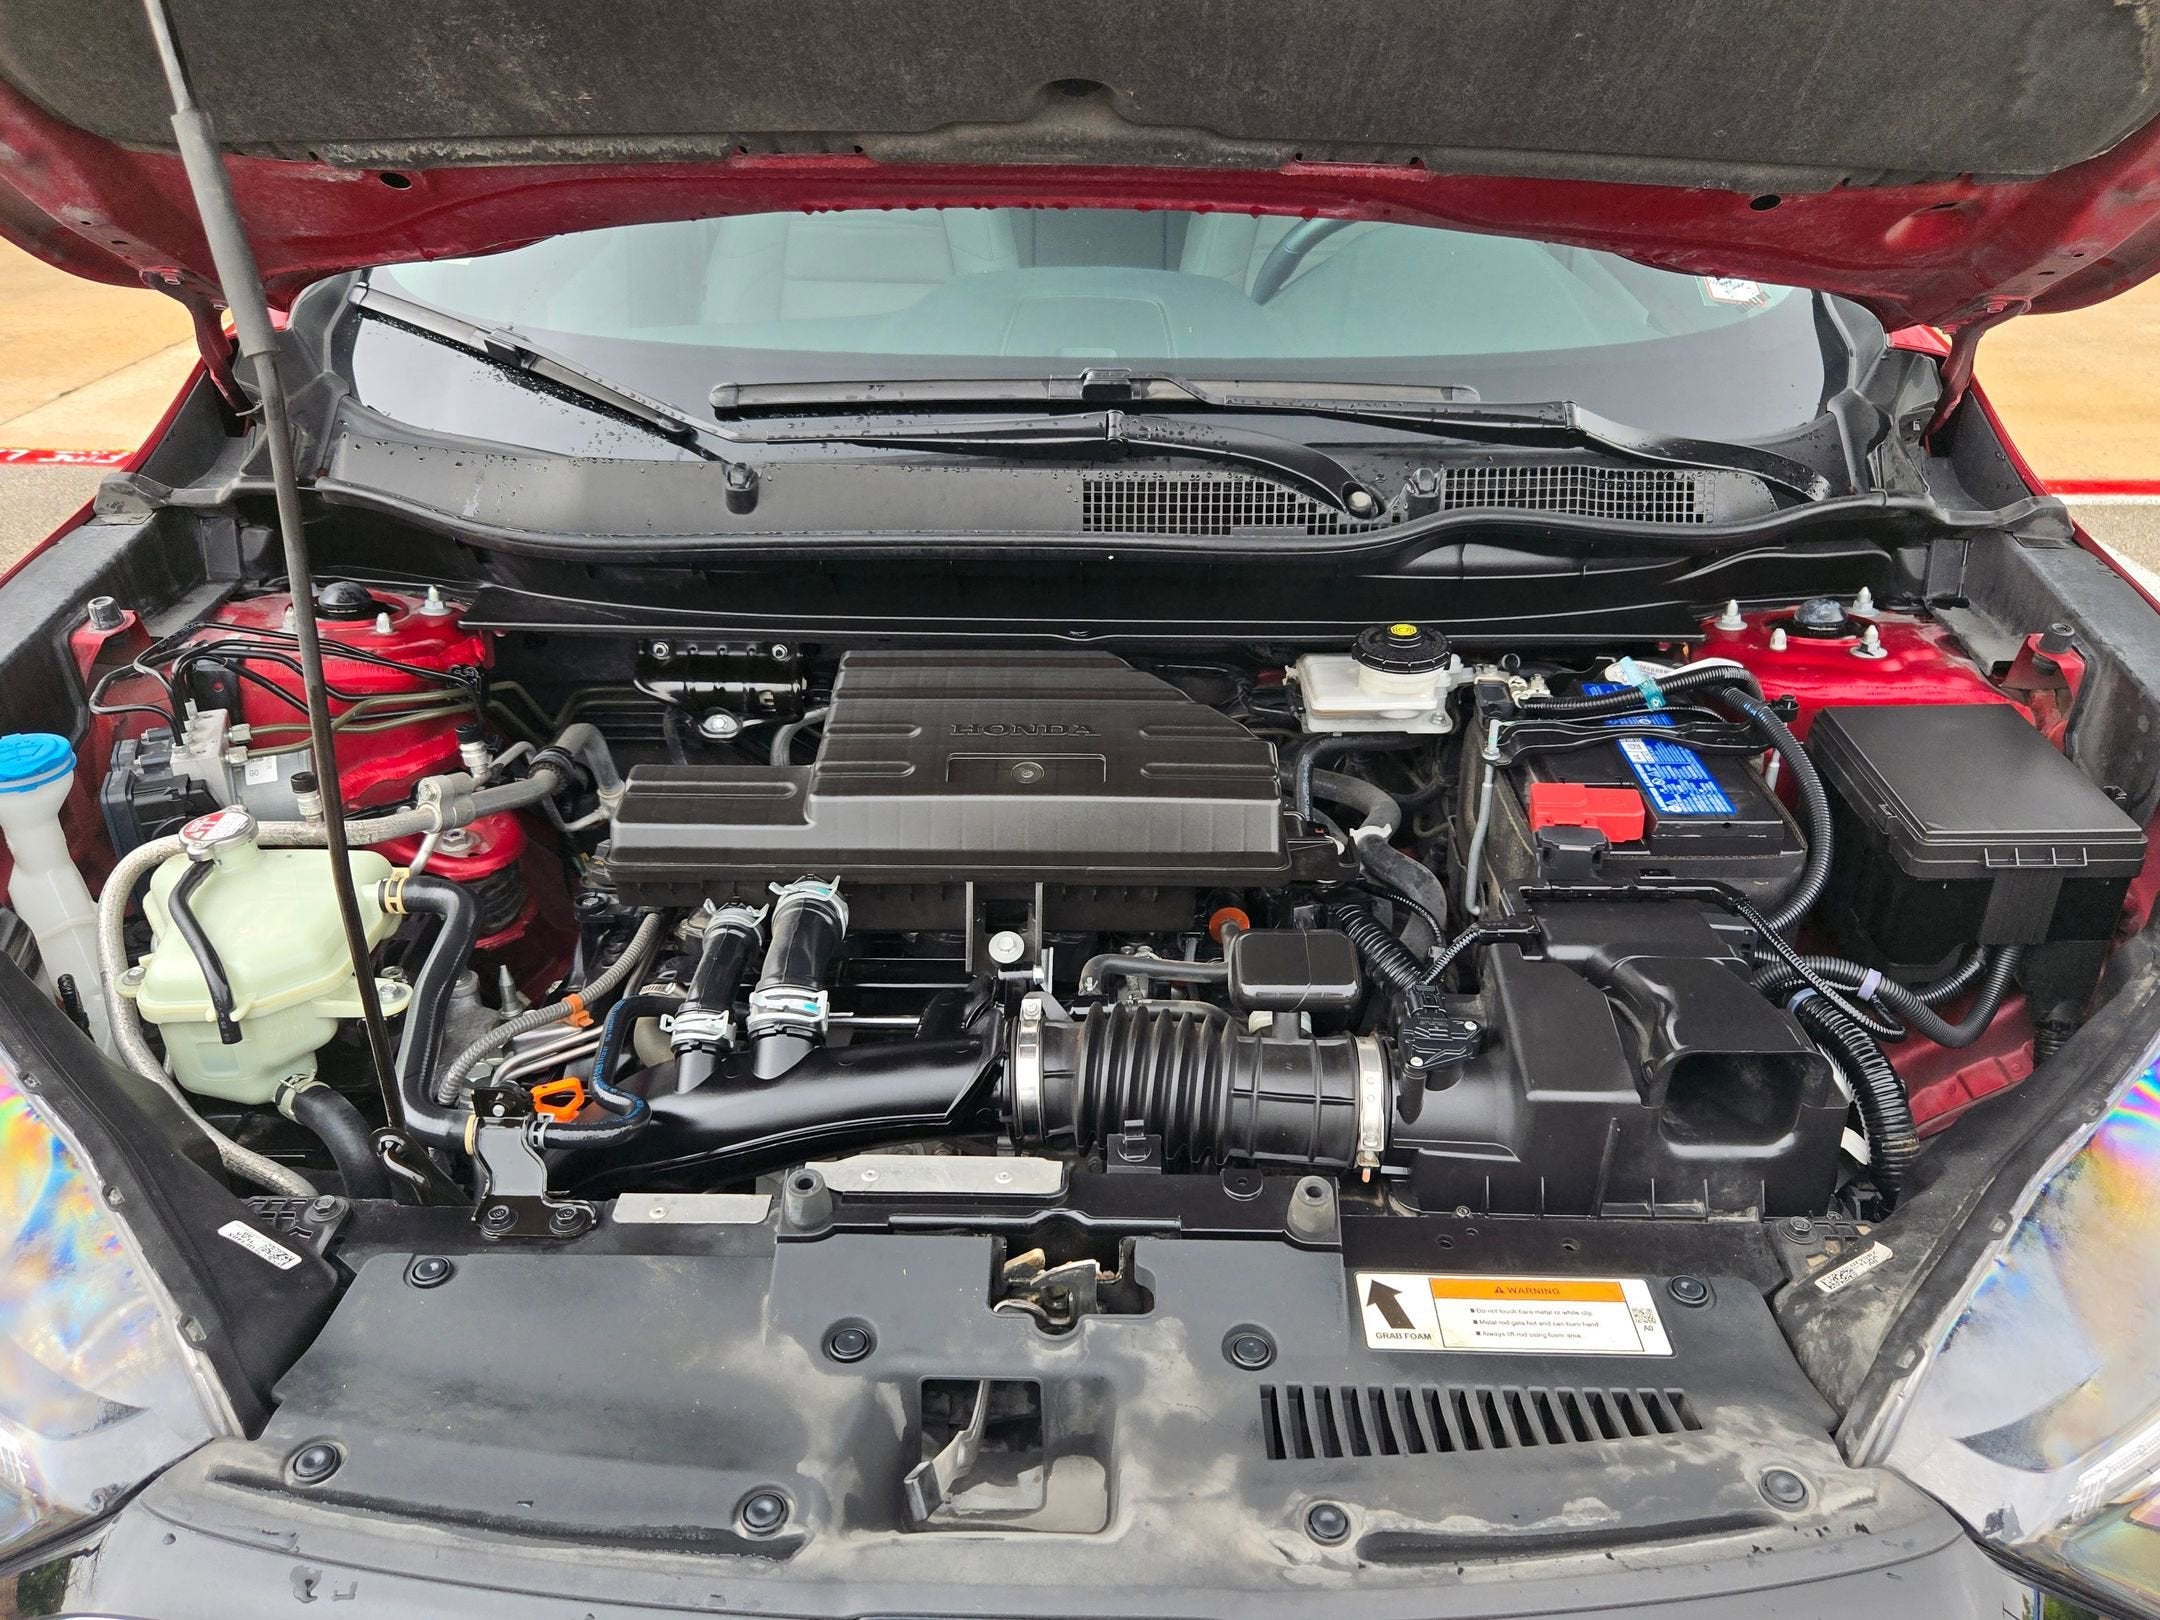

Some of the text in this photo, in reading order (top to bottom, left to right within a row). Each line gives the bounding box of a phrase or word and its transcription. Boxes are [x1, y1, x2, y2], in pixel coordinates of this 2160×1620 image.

[950, 723, 1102, 737] HONDA
[1507, 1287, 1561, 1296] WARNING
[1375, 1332, 1432, 1340] GRAB FOAM
